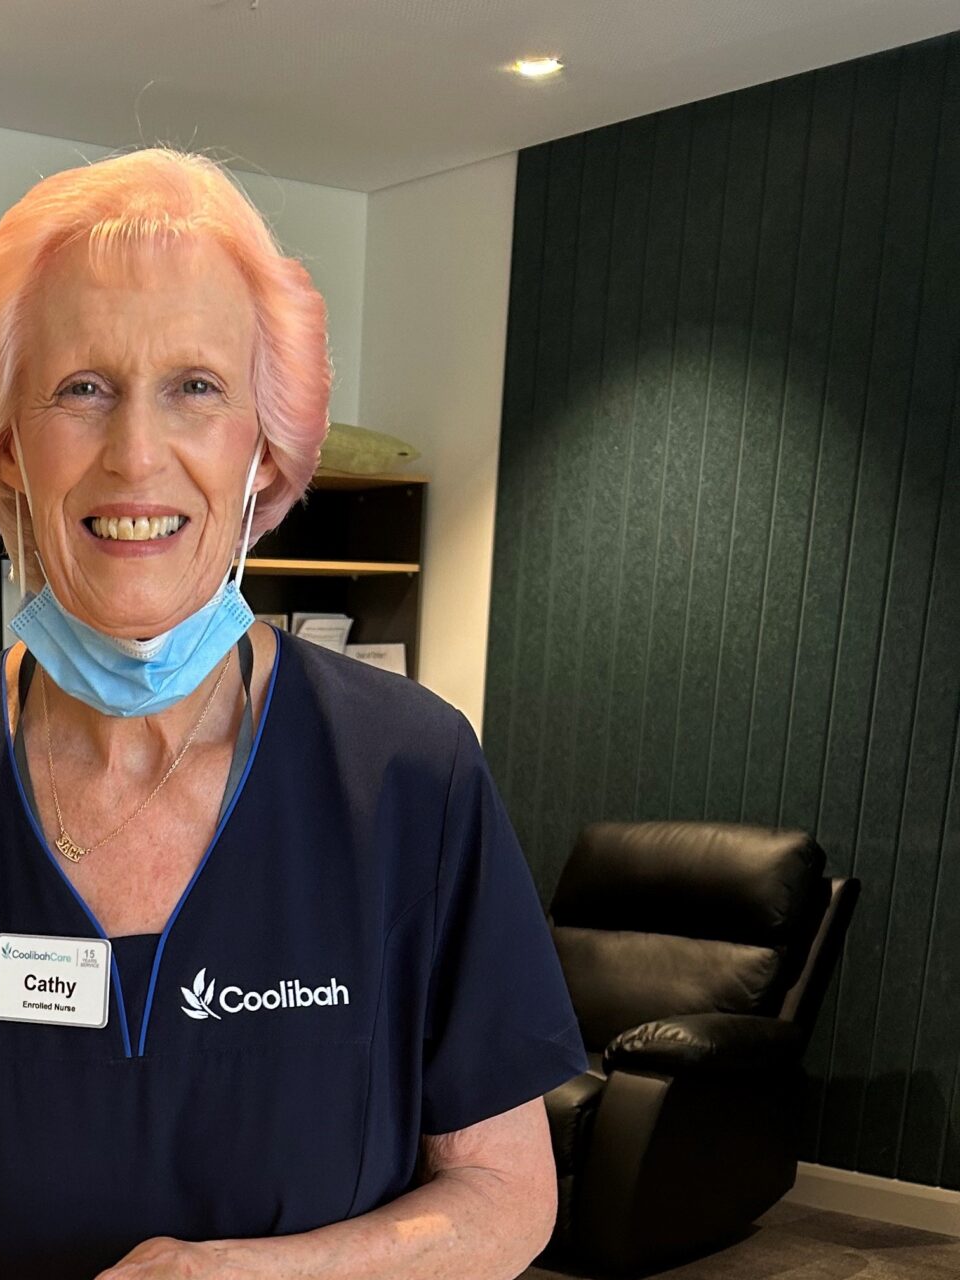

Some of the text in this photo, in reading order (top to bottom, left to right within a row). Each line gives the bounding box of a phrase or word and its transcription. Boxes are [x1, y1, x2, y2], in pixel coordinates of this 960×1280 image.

[12, 949, 72, 963] CoolibahCare
[84, 949, 96, 959] 15
[24, 974, 77, 999] Cathy
[219, 977, 350, 1014] Coolibah
[22, 1000, 76, 1013] Enrolled Nurse
